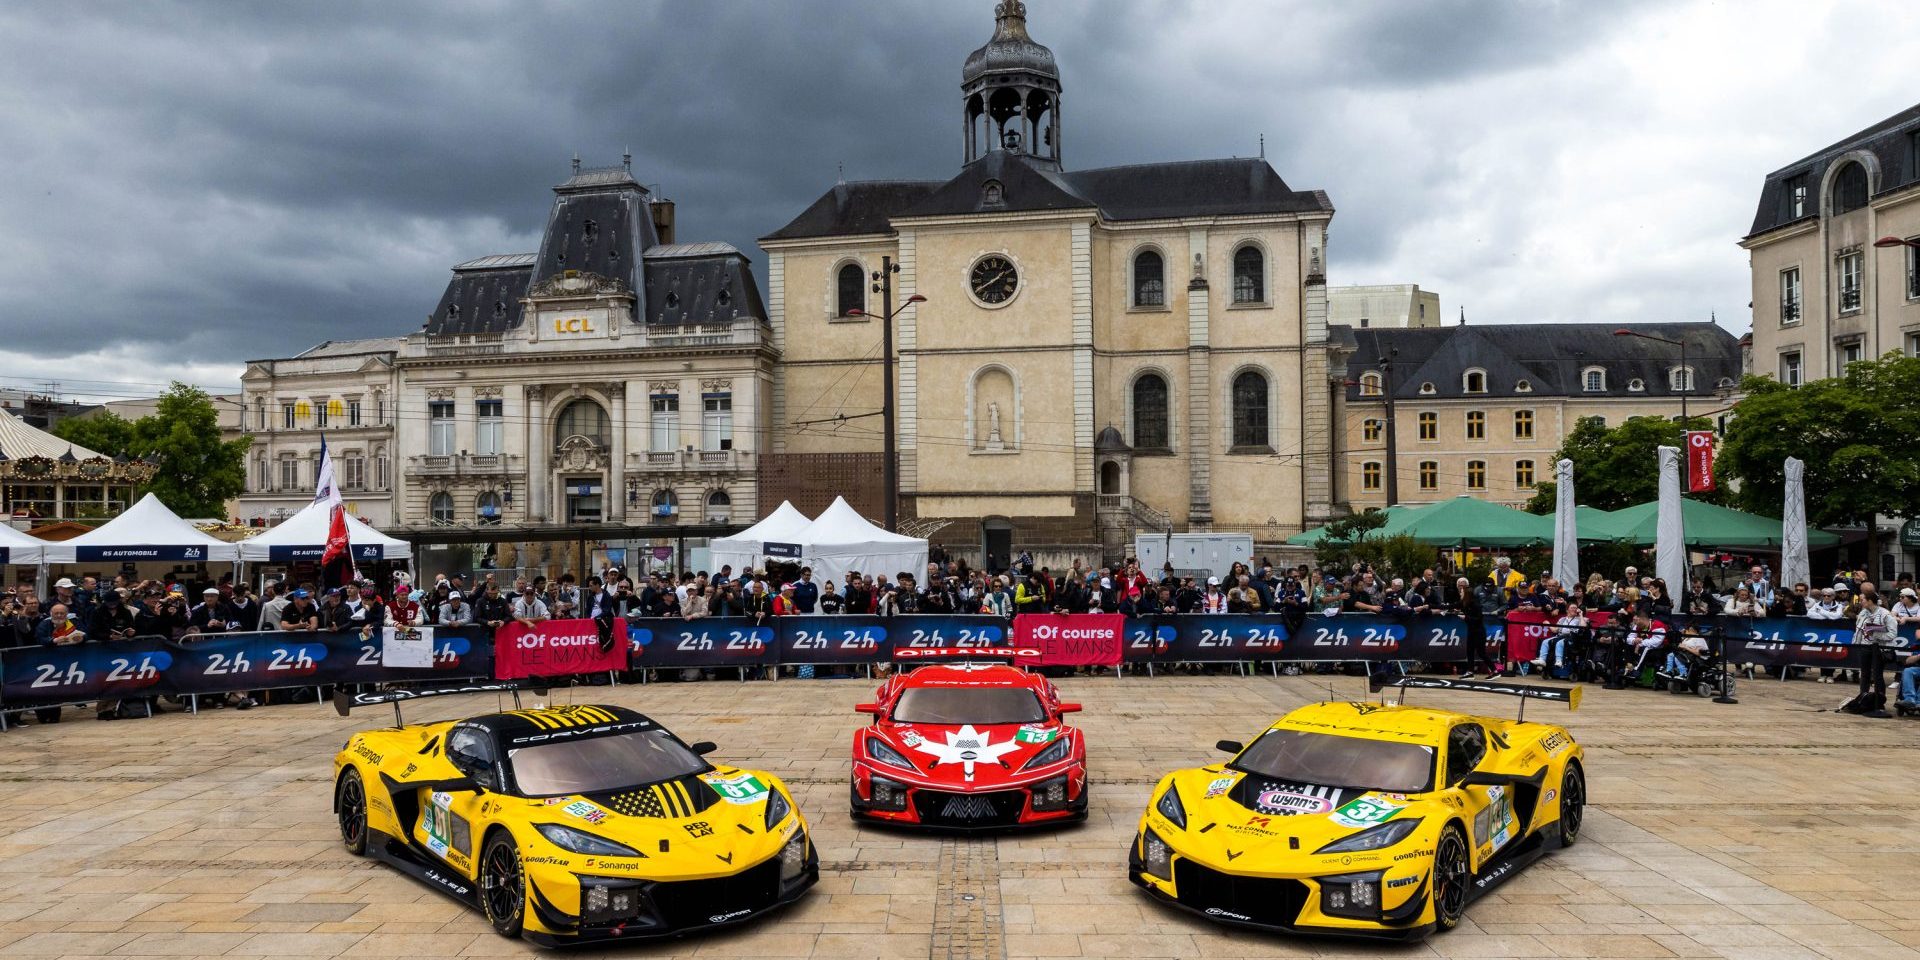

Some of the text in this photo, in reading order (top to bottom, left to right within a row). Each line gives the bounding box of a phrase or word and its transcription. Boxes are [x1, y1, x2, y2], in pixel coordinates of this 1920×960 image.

[555, 318, 594, 333] LCL
[677, 631, 713, 650] 24h
[726, 630, 762, 649] 24h
[792, 630, 827, 649] 24h
[840, 630, 875, 649] 24h
[1032, 625, 1114, 639] :Of course
[1198, 629, 1233, 647] 24h
[1245, 629, 1279, 647] 24h
[1314, 628, 1348, 646] 24h
[1361, 628, 1395, 646] 24h
[517, 633, 601, 649] :Of cours
[1065, 640, 1114, 655] MANS
[203, 651, 250, 675] 24h
[268, 648, 312, 671] 24h
[522, 650, 544, 665] LE
[31, 661, 86, 688] 24h
[106, 656, 157, 682] 24h
[513, 720, 650, 743] CORVETTE
[1285, 718, 1429, 738] CORVETTE
[1025, 731, 1050, 743] 13
[354, 742, 385, 766] Sonangol
[720, 780, 758, 798] 81
[567, 802, 586, 811] LM
[574, 805, 595, 816] GT3
[683, 821, 709, 831] REP
[689, 827, 715, 839] LAY
[1244, 824, 1279, 836] CONNECT
[525, 856, 570, 867] GOODYEAR
[1393, 850, 1434, 861] GOODYEAR
[598, 860, 639, 871] Sonangol
[725, 909, 752, 918] SPORT
[1222, 911, 1251, 920] SPORT
